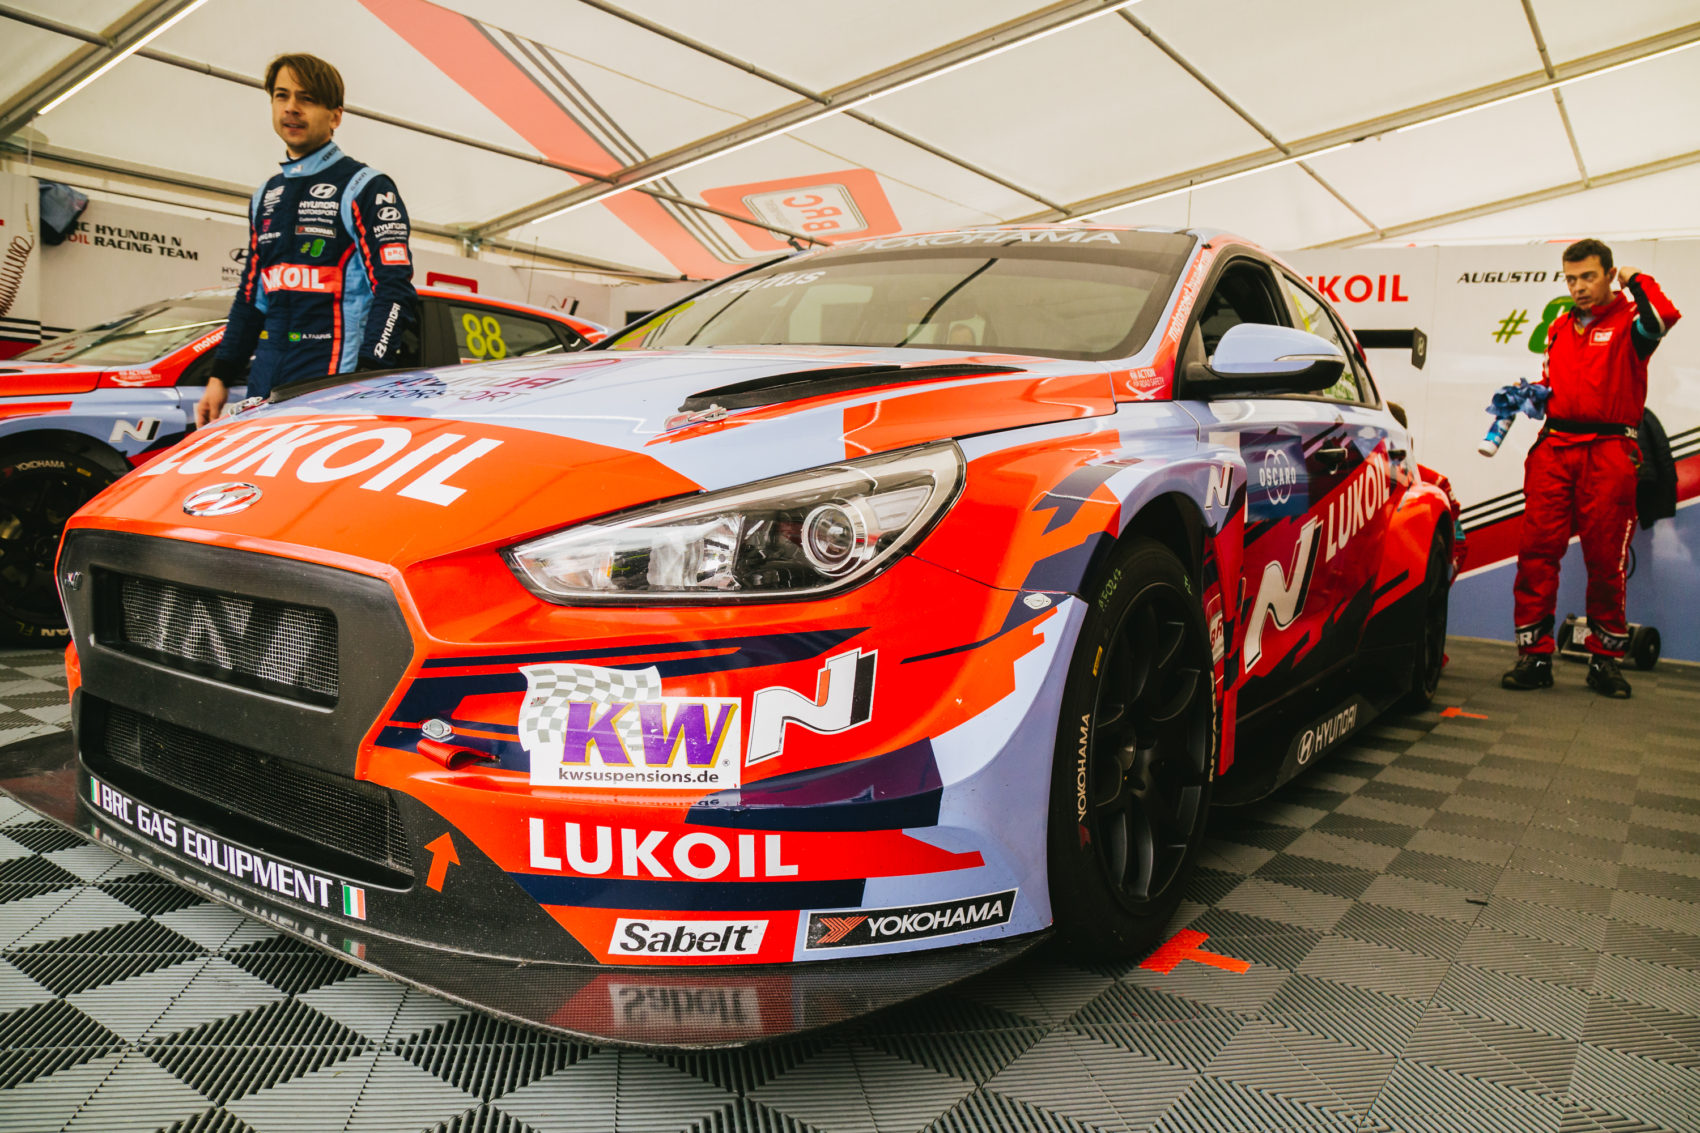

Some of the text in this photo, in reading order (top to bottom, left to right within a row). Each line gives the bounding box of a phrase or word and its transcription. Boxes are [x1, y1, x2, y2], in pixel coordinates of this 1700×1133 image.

[297, 208, 338, 217] MOTORSPORT
[299, 200, 340, 211] HYUNDAI
[69, 233, 199, 261] OIL RACING TEAM
[74, 221, 182, 247] C HYUNDAI N
[858, 231, 1121, 252] YOKOHAMA
[1457, 271, 1547, 284] AUGUSTO
[379, 302, 401, 345] HYUNDAI
[462, 313, 507, 359] 88
[1137, 367, 1157, 379] ACTION
[16, 459, 66, 471] YOKOHAMA
[138, 424, 504, 507] LUKOIL
[1259, 467, 1297, 487] OSCARO
[1326, 453, 1390, 563] LUKOIL
[41, 627, 70, 637] AN
[560, 701, 739, 768] KW
[1315, 703, 1358, 753] HYUNDAI
[558, 767, 719, 785] kwsuspensions.de
[1077, 713, 1091, 822] YOKOHAMA
[102, 784, 333, 908] BRC GAS EQUIPMENT
[529, 817, 799, 879] LUKOIL
[867, 900, 1004, 936] YOKOHAMA
[619, 922, 755, 954] Sabelt
